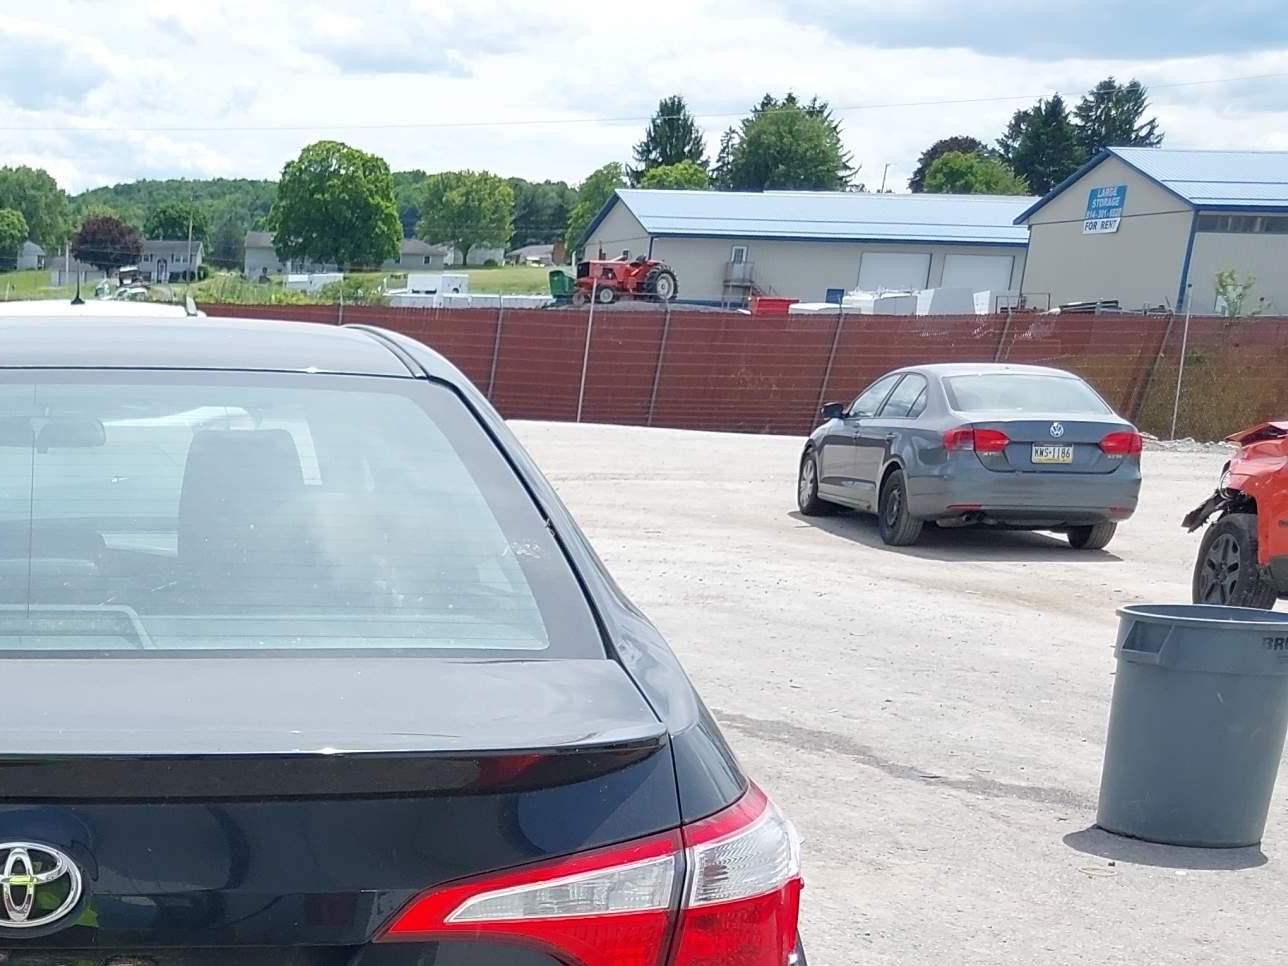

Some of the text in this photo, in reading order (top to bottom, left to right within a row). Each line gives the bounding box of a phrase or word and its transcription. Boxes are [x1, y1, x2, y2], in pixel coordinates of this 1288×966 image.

[1098, 187, 1118, 197] LARGE
[1092, 197, 1121, 208] STORAGE
[1085, 220, 1117, 231] FOR RENT
